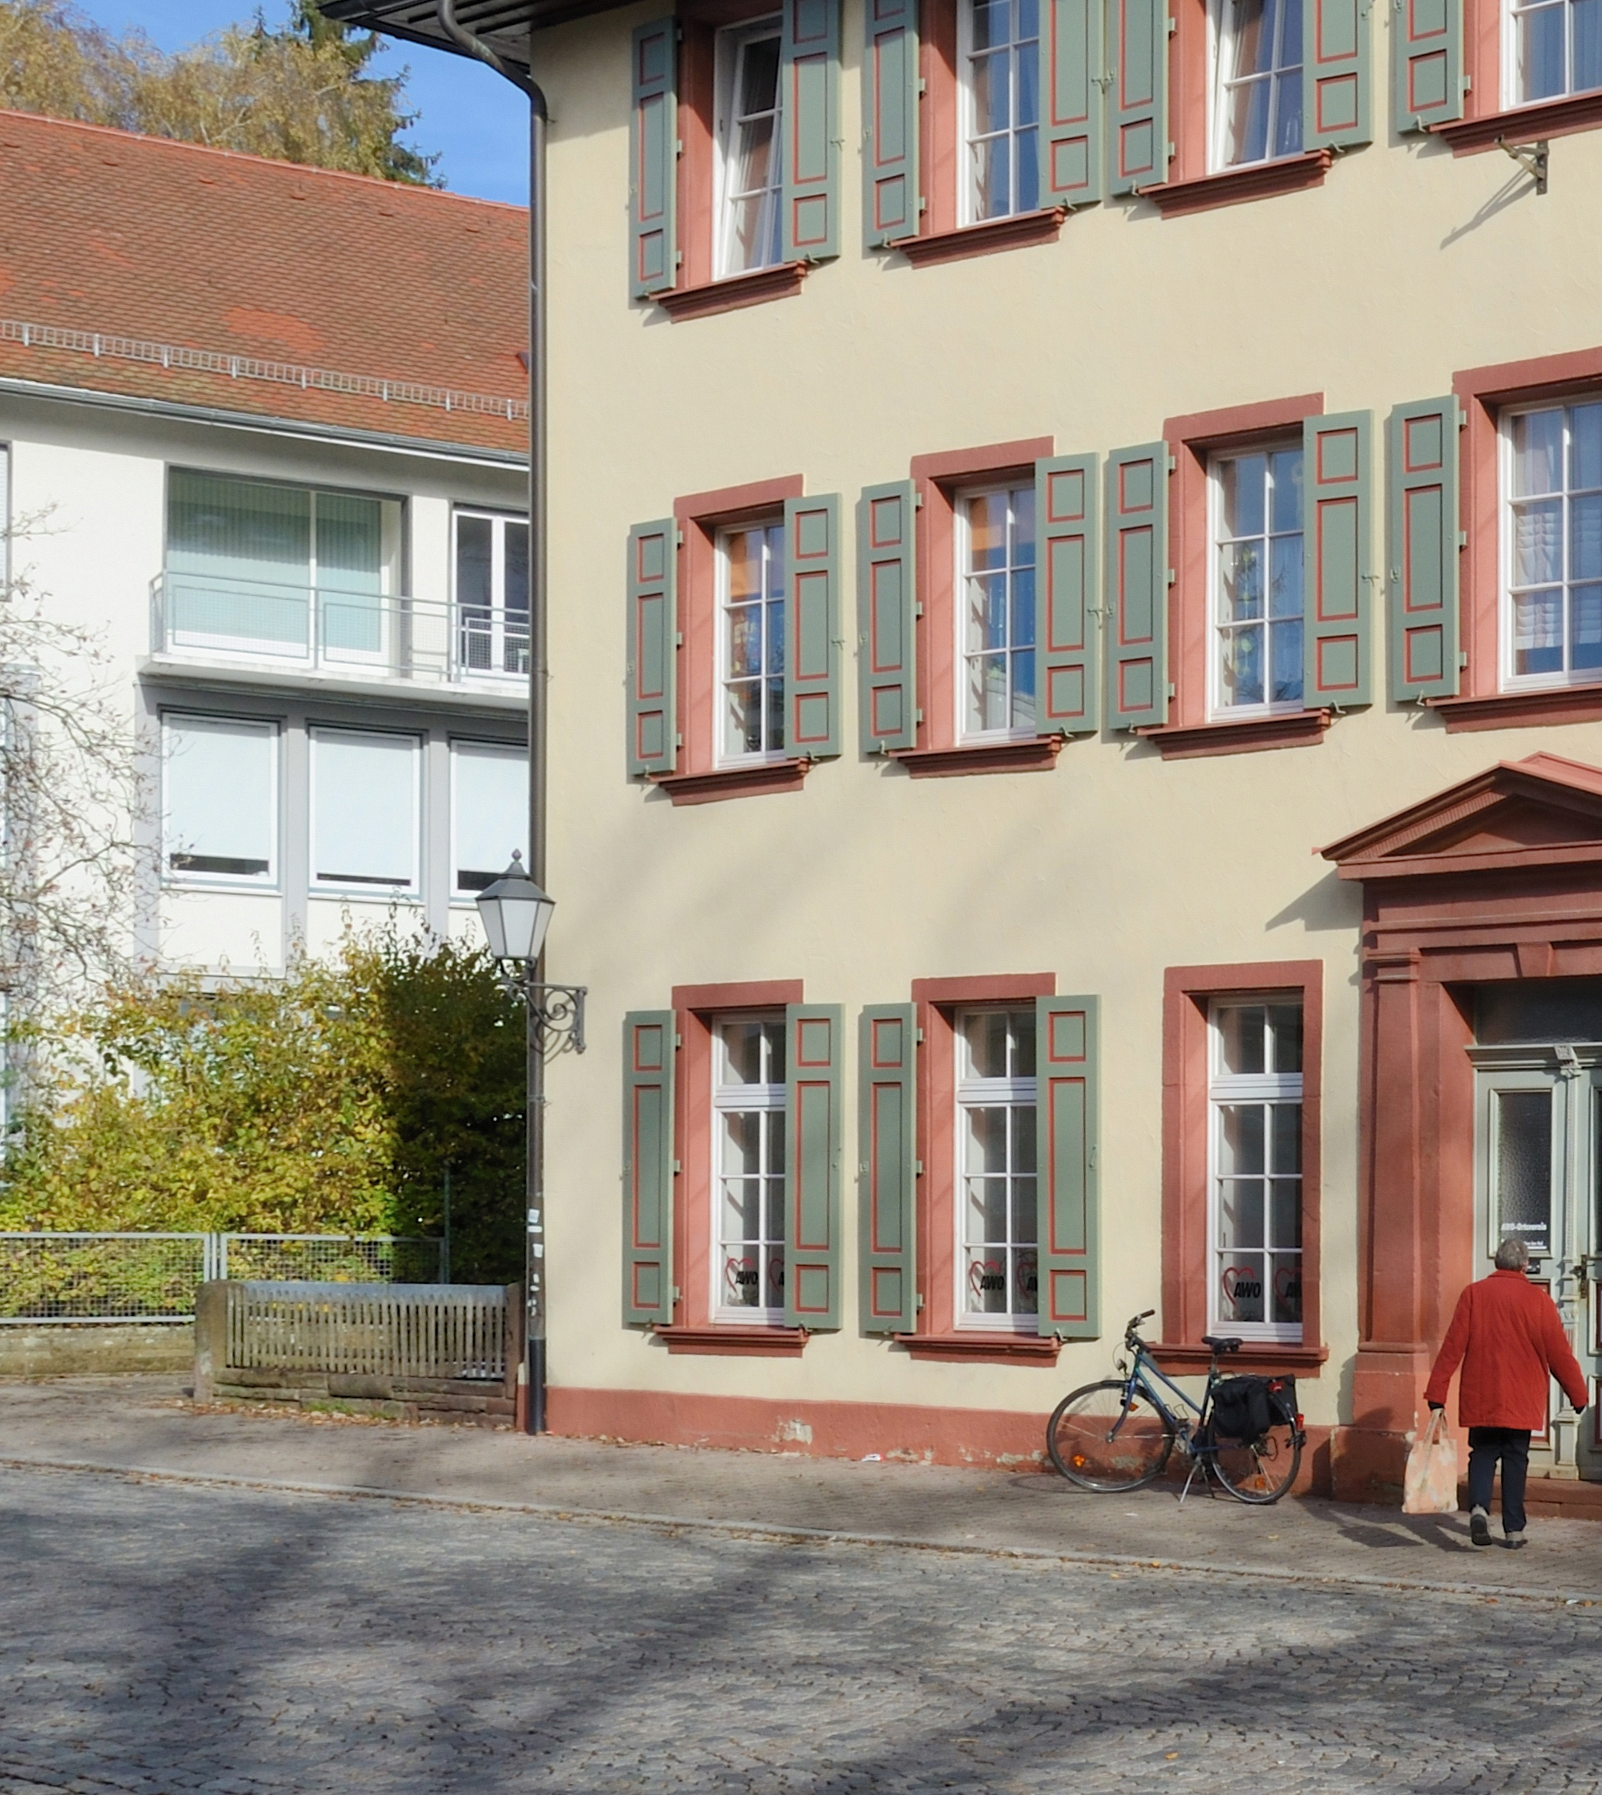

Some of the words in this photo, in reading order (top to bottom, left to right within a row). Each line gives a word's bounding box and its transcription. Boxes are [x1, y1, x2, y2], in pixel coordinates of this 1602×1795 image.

[735, 1271, 759, 1285] AWO
[980, 1275, 1005, 1290] AWO
[1233, 1282, 1262, 1298] AWO
